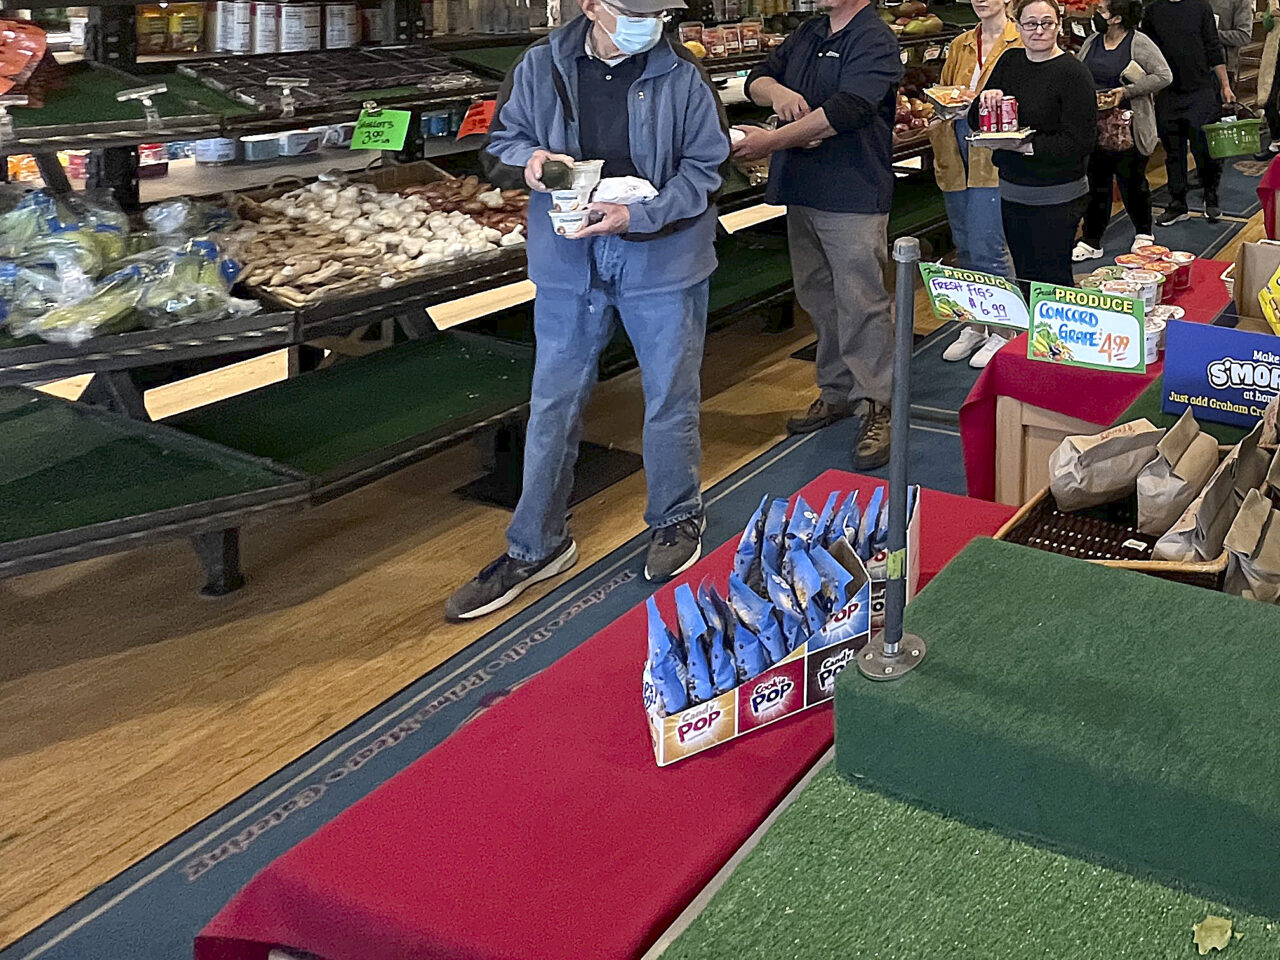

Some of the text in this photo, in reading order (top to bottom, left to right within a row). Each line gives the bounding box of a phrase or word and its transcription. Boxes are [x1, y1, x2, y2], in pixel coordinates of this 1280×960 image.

[931, 278, 995, 299] FRESH FIGS
[1055, 288, 1134, 313] PRODUCE
[1039, 302, 1099, 328] CONCORD
[1058, 324, 1100, 347] GRAPE
[1253, 350, 1280, 364] Make
[1168, 391, 1267, 418] Just add Graham Cra
[1243, 390, 1277, 404] at hom
[561, 569, 638, 622] Produce
[823, 648, 855, 670] Candy
[754, 676, 787, 694] Cookie
[818, 660, 844, 689] PO
[751, 681, 793, 715] POP
[681, 702, 717, 723] Candy
[676, 709, 722, 743] POP
[348, 717, 422, 772] Meat
[182, 783, 327, 882] Catering
